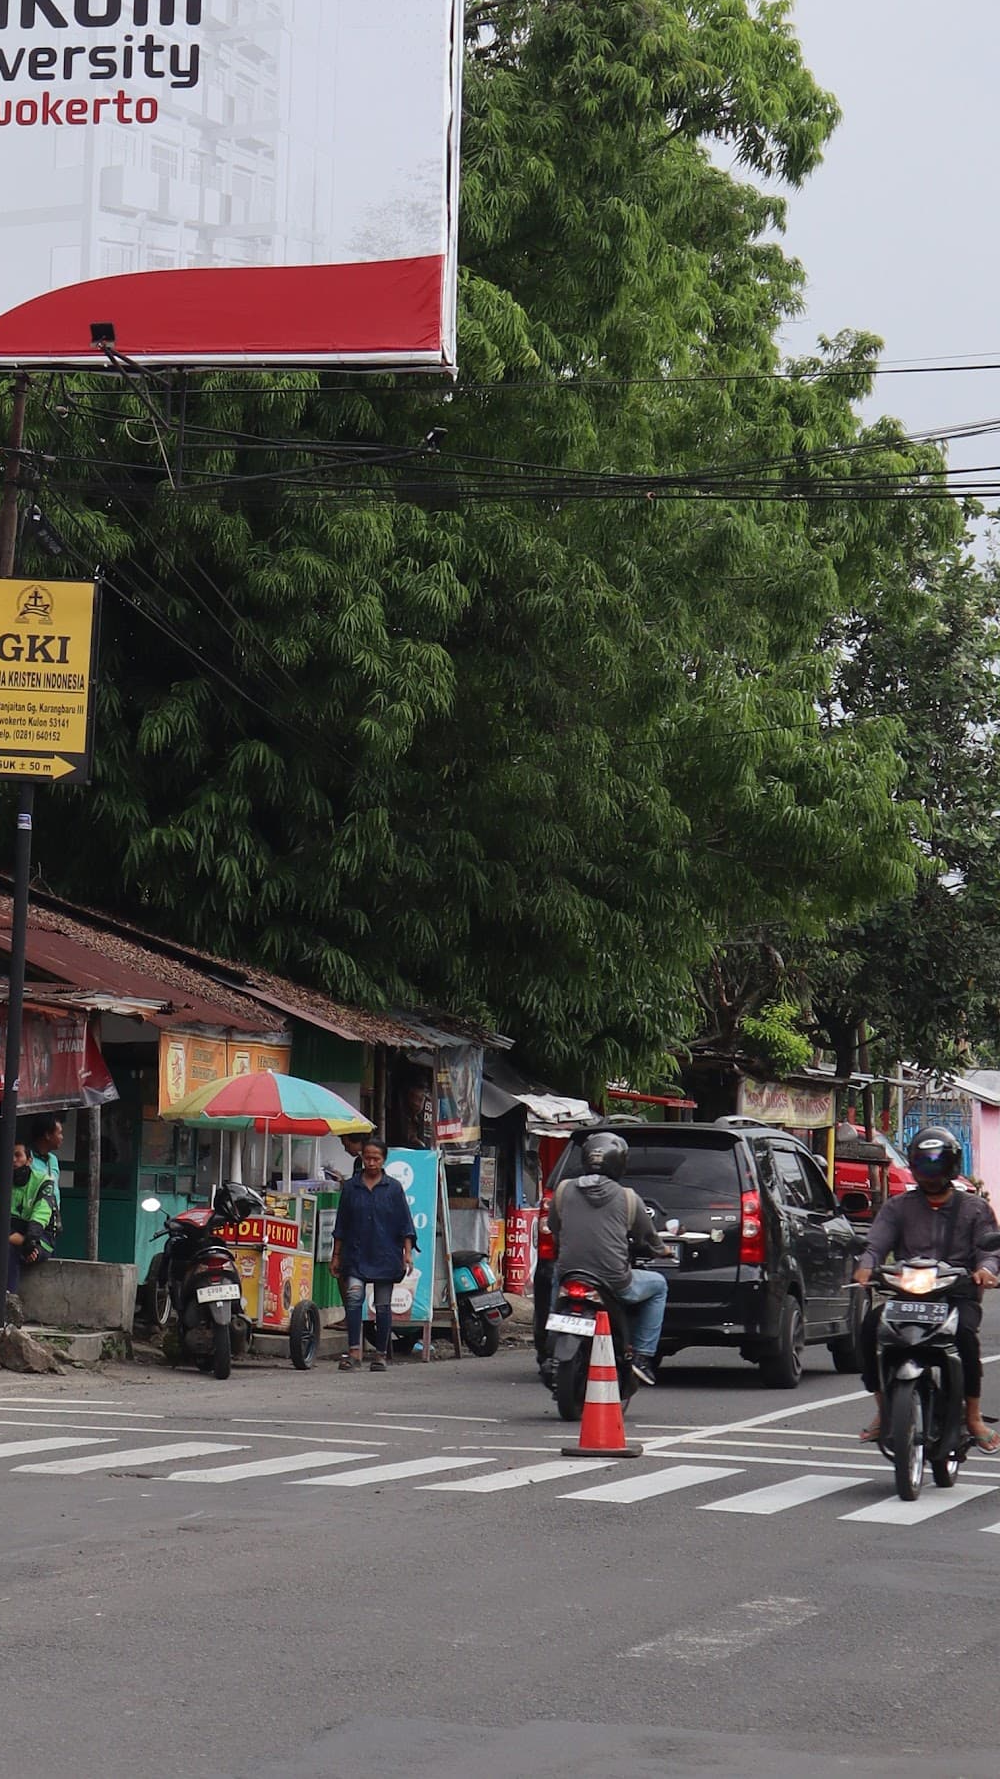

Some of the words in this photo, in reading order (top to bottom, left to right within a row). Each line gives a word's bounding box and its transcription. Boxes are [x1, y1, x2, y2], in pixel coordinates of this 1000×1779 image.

[8, 671, 41, 688] KRISTEN
[43, 672, 85, 690] INDONESIA
[27, 702, 38, 714] Gg.
[39, 703, 76, 715] Karangbaru
[76, 705, 84, 715] III
[28, 716, 48, 727] Kulon
[49, 718, 69, 729] 53141
[13, 730, 35, 742] (0281)
[36, 730, 61, 741] 640152
[29, 762, 41, 771] 50
[266, 1224, 296, 1243] PENTOL
